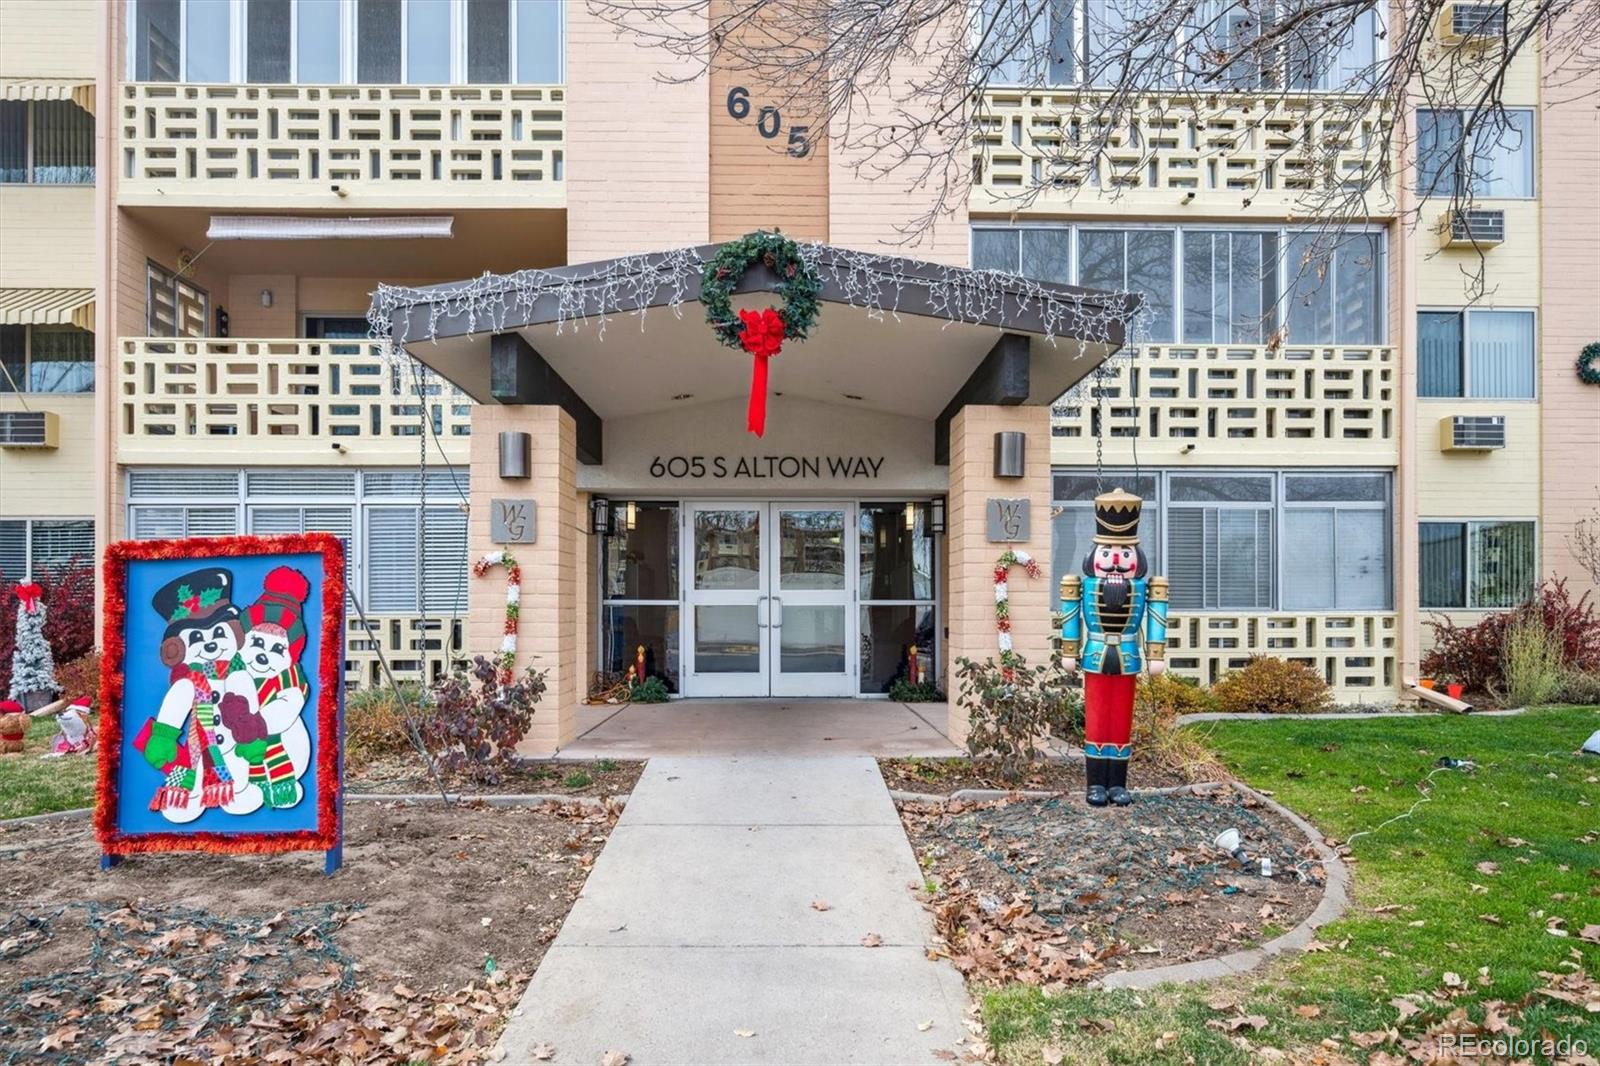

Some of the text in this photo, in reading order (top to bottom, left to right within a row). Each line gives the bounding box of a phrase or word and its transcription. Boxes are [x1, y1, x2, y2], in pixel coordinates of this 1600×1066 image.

[727, 86, 811, 158] 605
[650, 456, 885, 478] 605 S ALTON WAY
